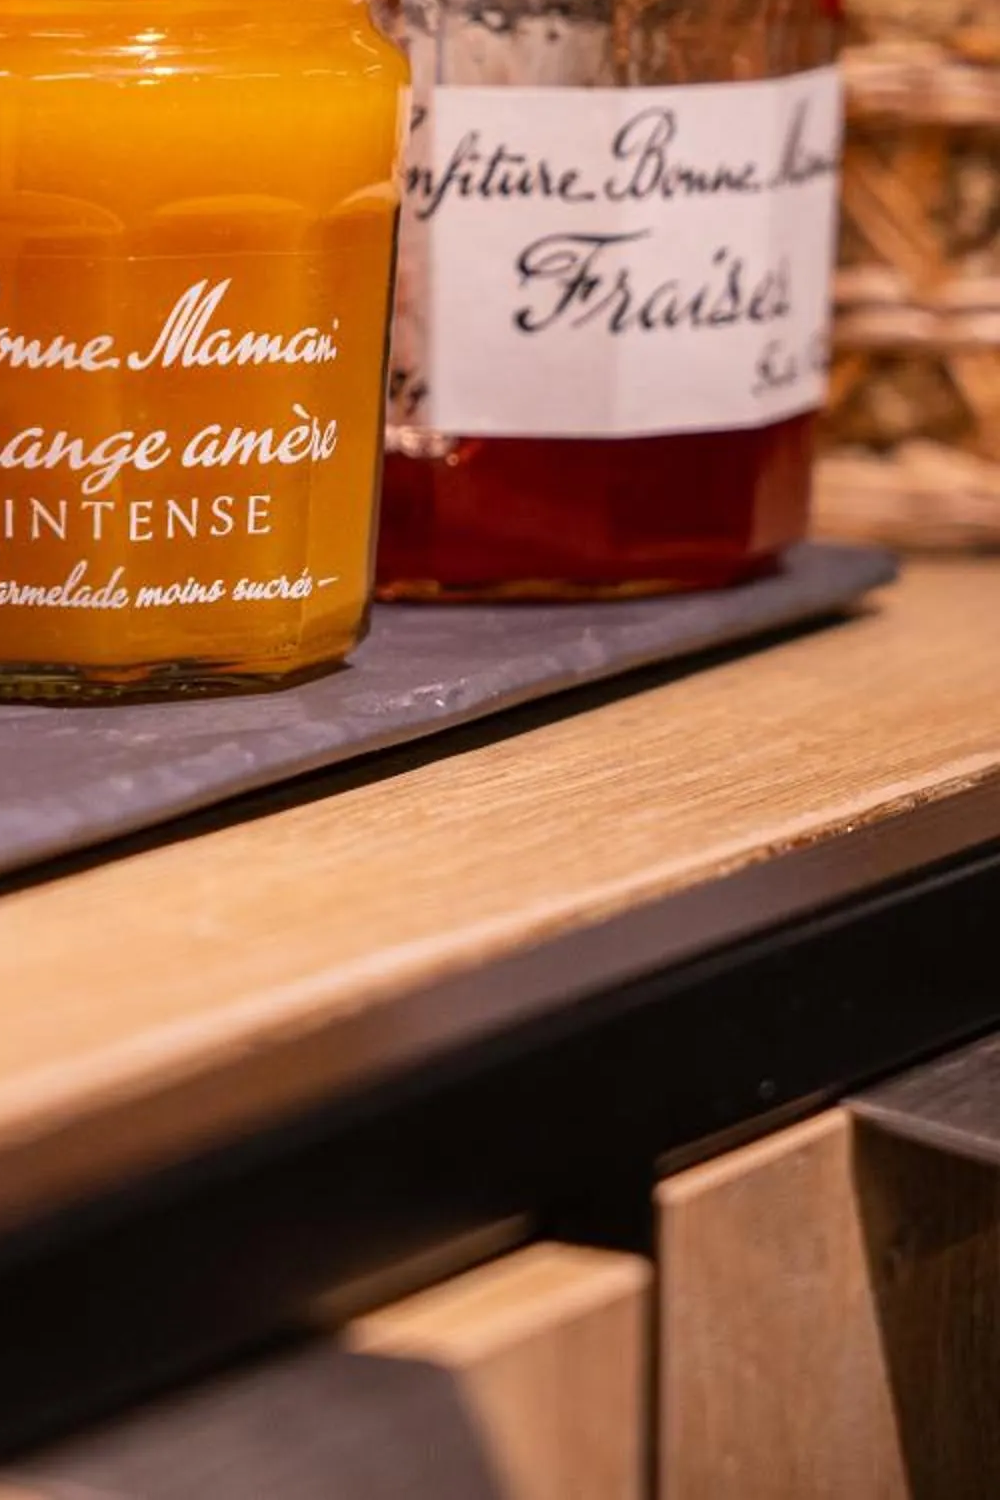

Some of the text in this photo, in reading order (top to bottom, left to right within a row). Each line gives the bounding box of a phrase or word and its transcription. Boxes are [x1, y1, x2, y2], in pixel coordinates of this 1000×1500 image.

[604, 105, 762, 200] Bonne
[180, 403, 338, 468] amère
[4, 495, 272, 542] INTENSE
[134, 574, 226, 609] moins
